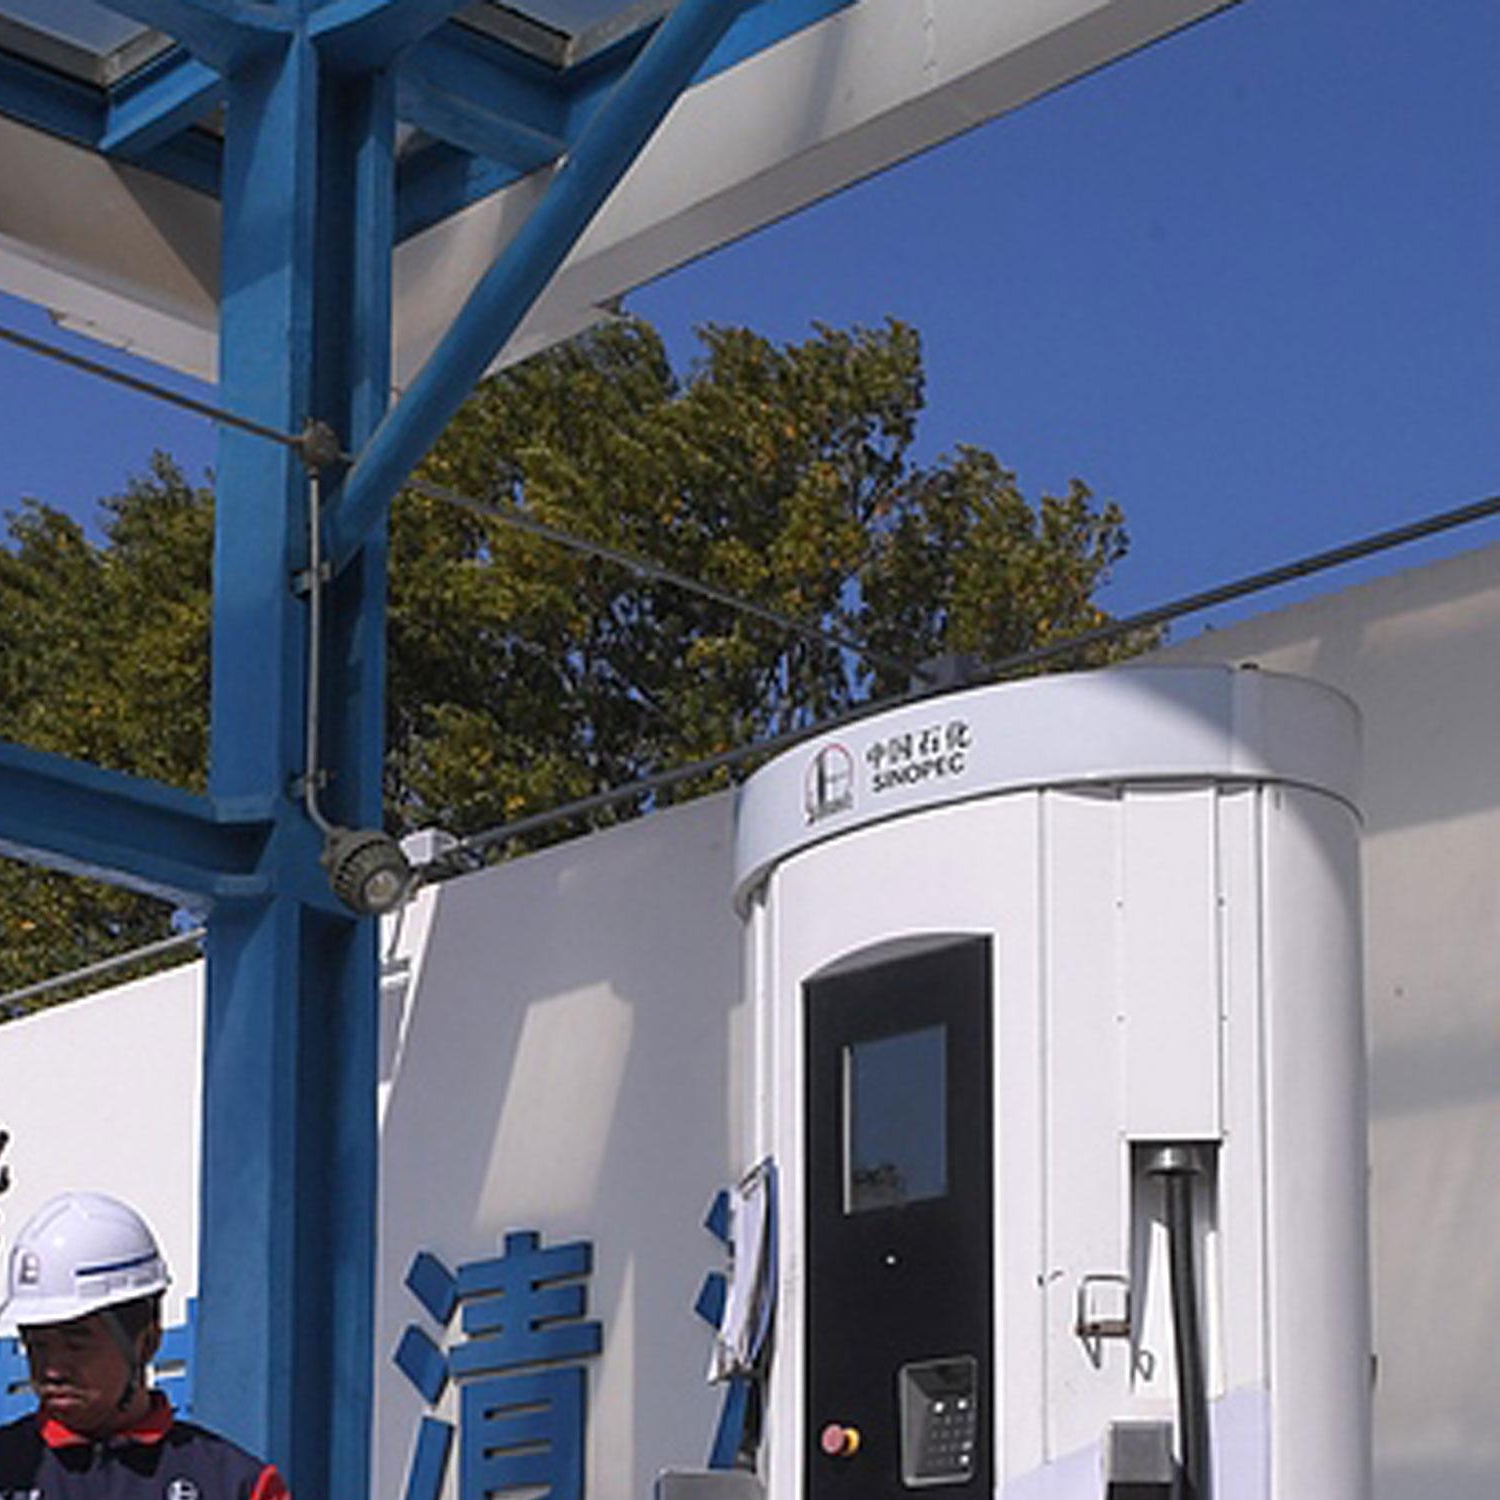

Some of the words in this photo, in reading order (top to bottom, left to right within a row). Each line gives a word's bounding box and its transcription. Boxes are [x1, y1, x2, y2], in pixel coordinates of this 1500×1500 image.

[866, 720, 971, 769] 中国石化
[873, 751, 965, 793] SINOPEC
